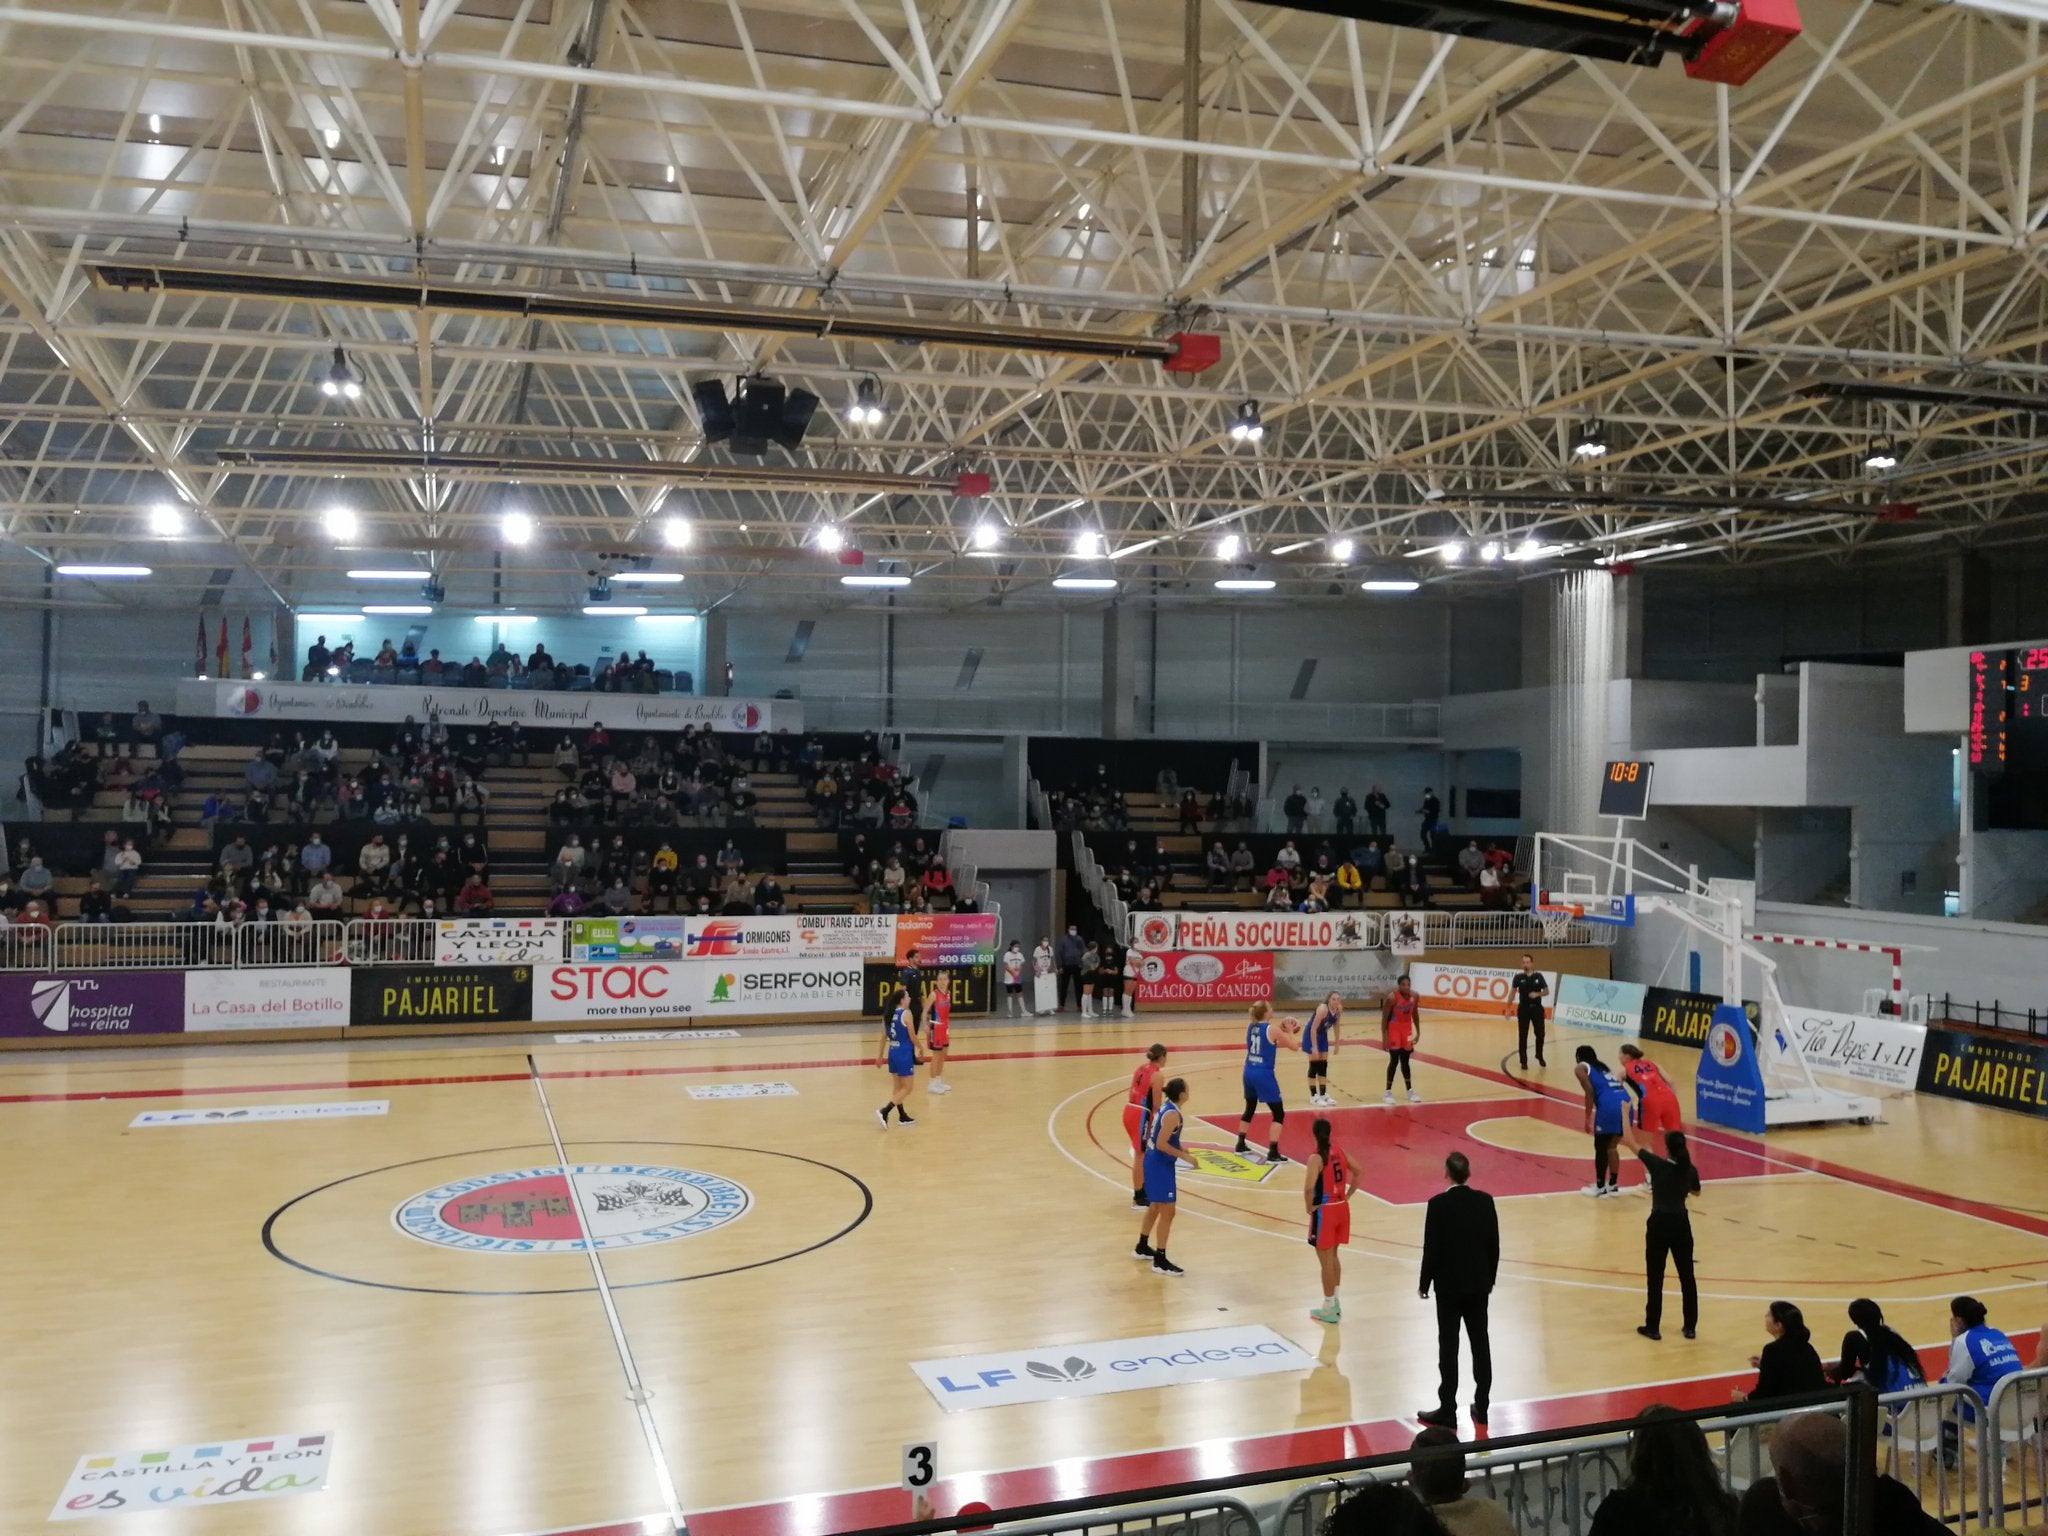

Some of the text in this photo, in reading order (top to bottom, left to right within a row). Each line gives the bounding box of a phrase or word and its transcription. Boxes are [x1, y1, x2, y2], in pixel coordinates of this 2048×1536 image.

[2020, 674, 2030, 692] 3
[474, 696, 527, 721] Deportivo
[533, 698, 592, 725] Municipal
[797, 916, 852, 929] COMBUTRANS
[897, 920, 933, 930] adamo
[441, 930, 556, 939] CASTILLA
[745, 930, 791, 944] ORMIGONES
[1180, 916, 1229, 947] PEÑA
[1235, 920, 1332, 947] SOCUELLO
[476, 938, 544, 949] LEÓN
[442, 948, 554, 962] es vida
[939, 954, 959, 963] 900
[960, 954, 976, 963] 651
[978, 954, 994, 963] 601
[406, 975, 480, 984] EMBUTIDOS
[1434, 966, 1488, 976] EXPLOTACIONES
[259, 978, 327, 988] RESTAURANTE
[743, 971, 862, 990] SERFONOR
[1433, 974, 1509, 1000] COFO
[743, 989, 862, 1001] MEDIOAMBIENTE
[1138, 983, 1270, 998] PALACIO DE CANEDO
[192, 998, 344, 1015] La Casa del Botillo
[383, 986, 499, 1016] PAJARIEL
[70, 1003, 133, 1019] hospital
[587, 1004, 692, 1016] more than you see
[1566, 1007, 1627, 1025] FISIOSALUD
[90, 1018, 130, 1030] reina
[1655, 1007, 1712, 1040] PAJAR
[1250, 1035, 1261, 1054] 21
[1831, 1021, 1870, 1065] Pepe
[1872, 1042, 1884, 1061] I
[1895, 1045, 1917, 1067] II
[1960, 1043, 2032, 1063] EMBUTIDOS
[1934, 1052, 2048, 1106] PAJARIEL
[936, 1340, 1290, 1393] LF endesa
[81, 1449, 323, 1481] CASTILLA Y LEÓN
[908, 1446, 934, 1487] 3
[66, 1466, 319, 1510] es vida
